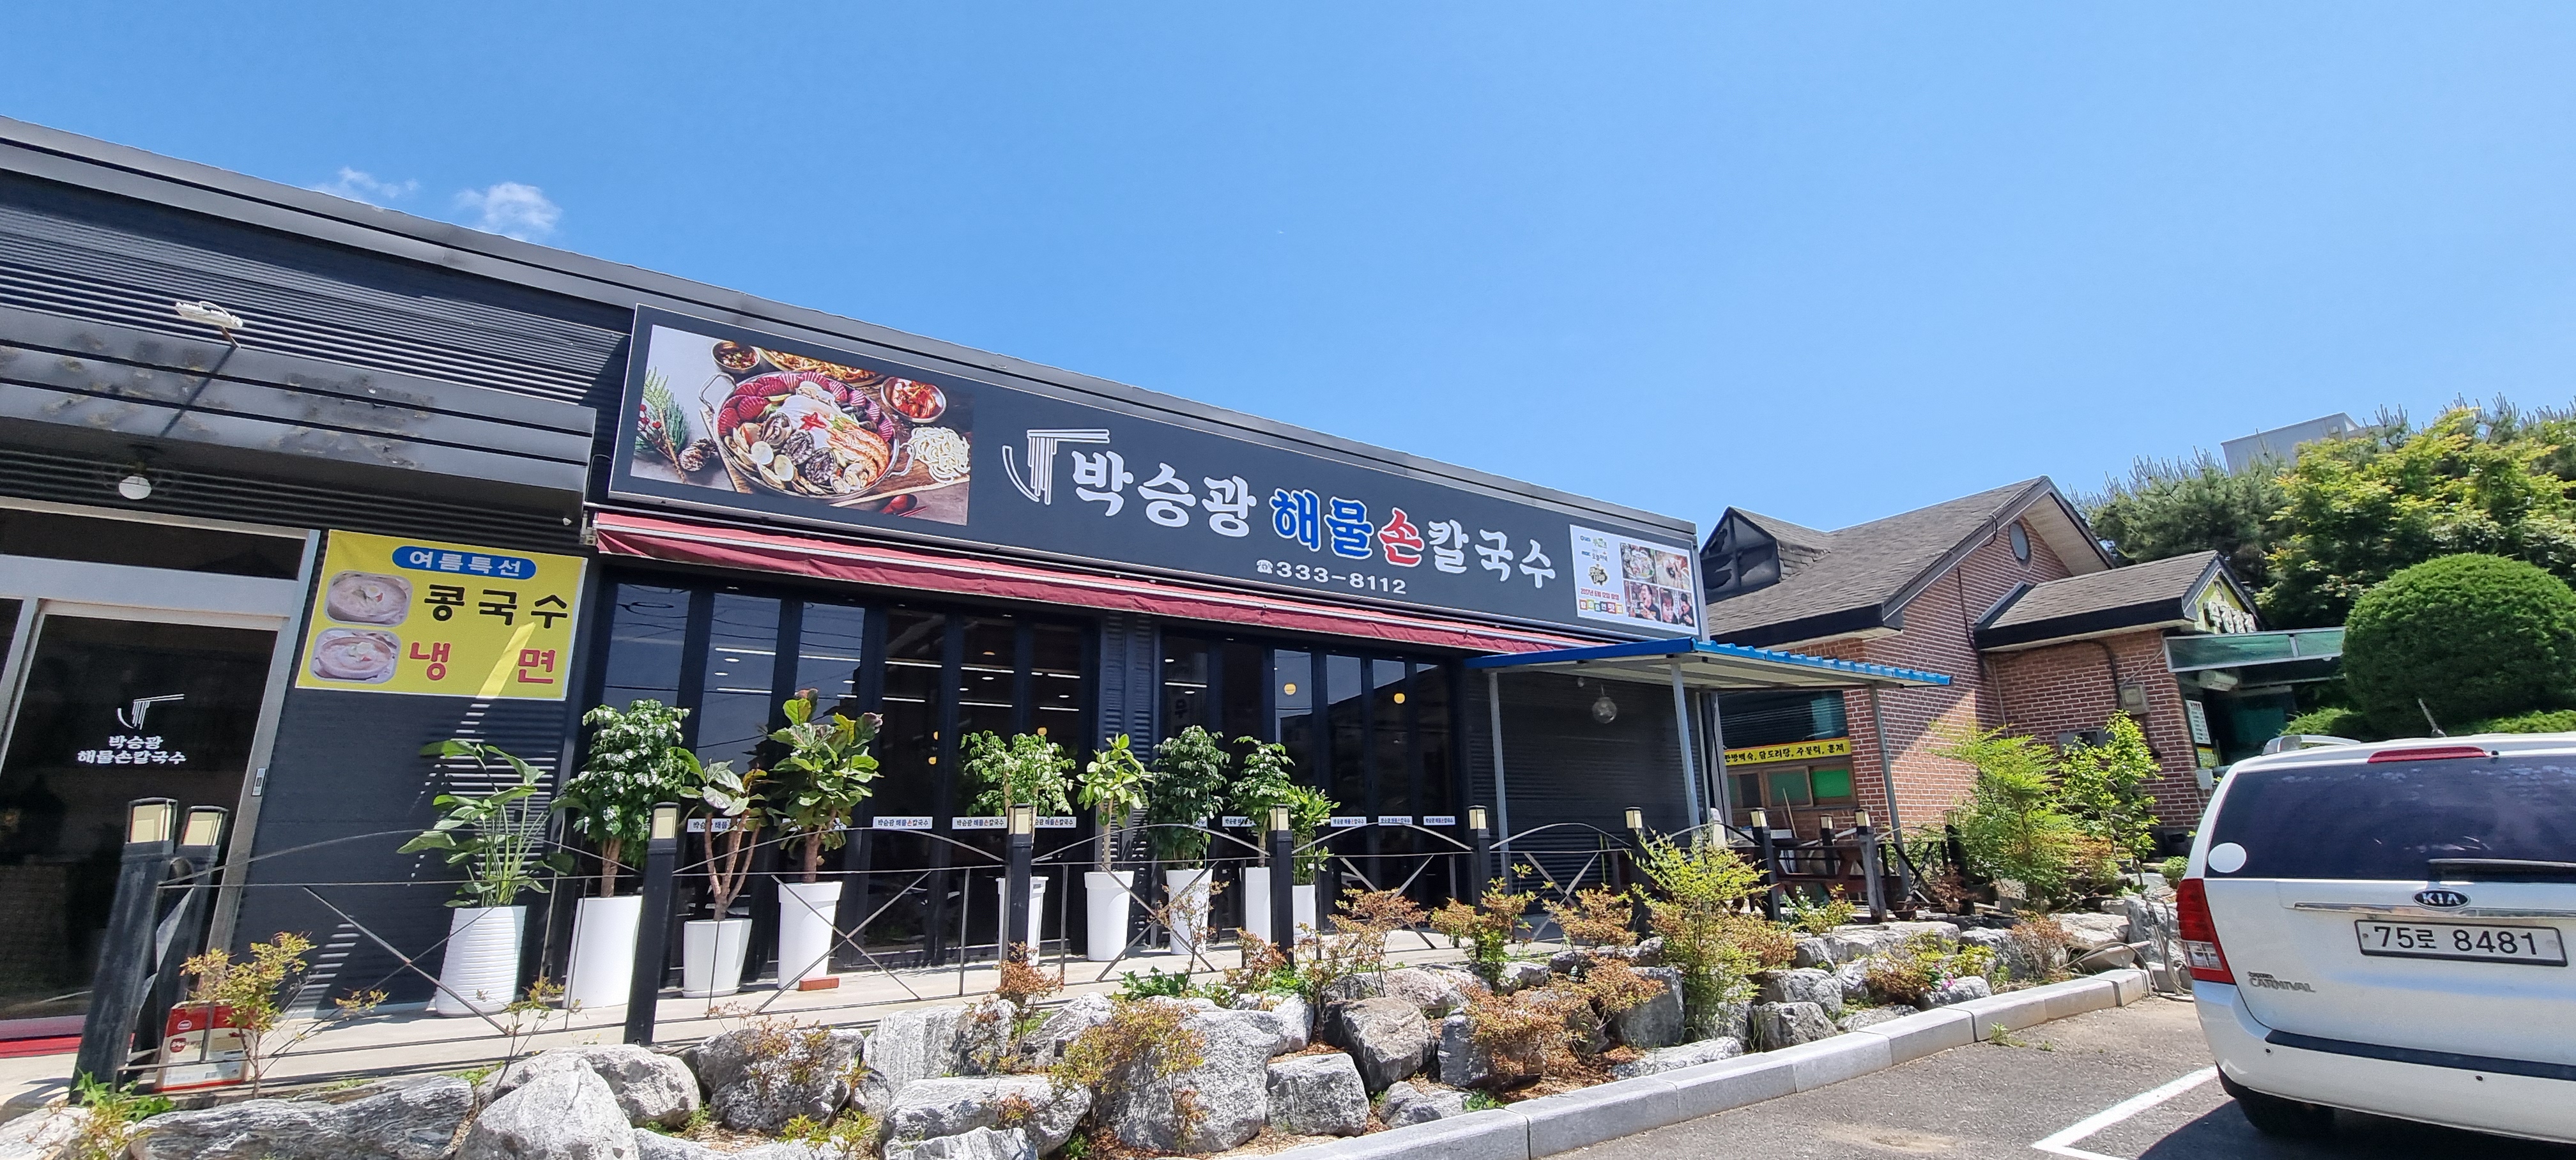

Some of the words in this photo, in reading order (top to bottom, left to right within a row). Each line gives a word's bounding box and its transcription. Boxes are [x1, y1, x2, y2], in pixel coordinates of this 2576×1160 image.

[1071, 450, 1257, 537] 박승광
[1269, 487, 1556, 588] 해물손칼국수
[410, 550, 521, 577] 여름특선
[1276, 561, 1407, 594] 333-8112
[424, 584, 567, 629] 콩국수
[109, 735, 164, 749] 박승광
[77, 750, 187, 765] 해물손칼국수
[693, 821, 705, 829] 박승
[2421, 893, 2460, 904] KIA
[2374, 926, 2437, 949] 75로
[2452, 929, 2537, 955] 8481
